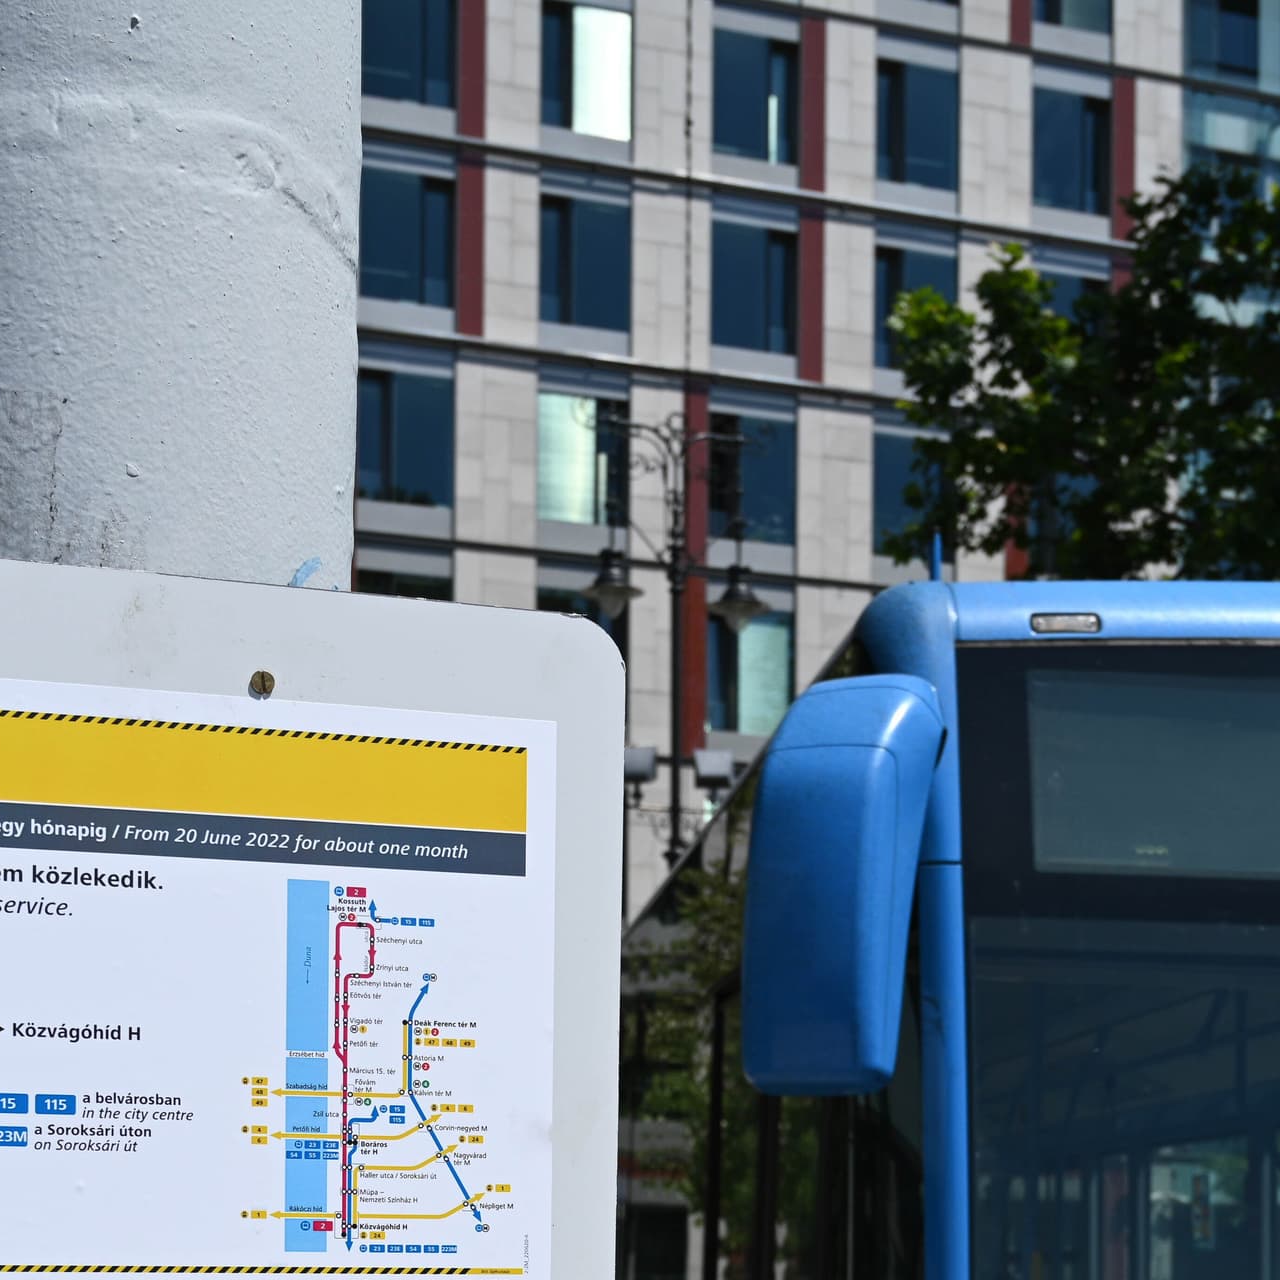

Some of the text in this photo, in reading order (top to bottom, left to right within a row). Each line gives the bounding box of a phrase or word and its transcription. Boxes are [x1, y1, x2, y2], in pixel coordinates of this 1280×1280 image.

[31, 818, 106, 842] hónapig
[112, 824, 120, 838] /
[124, 825, 169, 841] From
[174, 828, 197, 843] 20
[201, 830, 241, 846] June
[245, 832, 290, 848] 2022
[292, 834, 320, 853] for
[324, 837, 375, 853] about
[379, 843, 410, 855] one
[415, 844, 468, 859] month
[32, 865, 163, 889] közlekedik.
[376, 937, 407, 945] Széchenyi
[349, 1017, 372, 1025] Vigadó
[13, 1022, 121, 1043] Közvágóhíd
[128, 1026, 140, 1040] H
[0, 1098, 16, 1109] 15
[45, 1099, 67, 1110] 115
[82, 1095, 91, 1105] a
[96, 1092, 181, 1106] belvárosban
[82, 1107, 194, 1123] in the city centre
[34, 1126, 42, 1135] a
[48, 1124, 114, 1136] Soroksári
[119, 1125, 151, 1137] úton
[434, 1124, 480, 1133] Corvin-negyed
[34, 1139, 138, 1152] on Soroksári út
[479, 1203, 506, 1211] Népliget
[358, 1222, 401, 1232] Közvágóhíd
